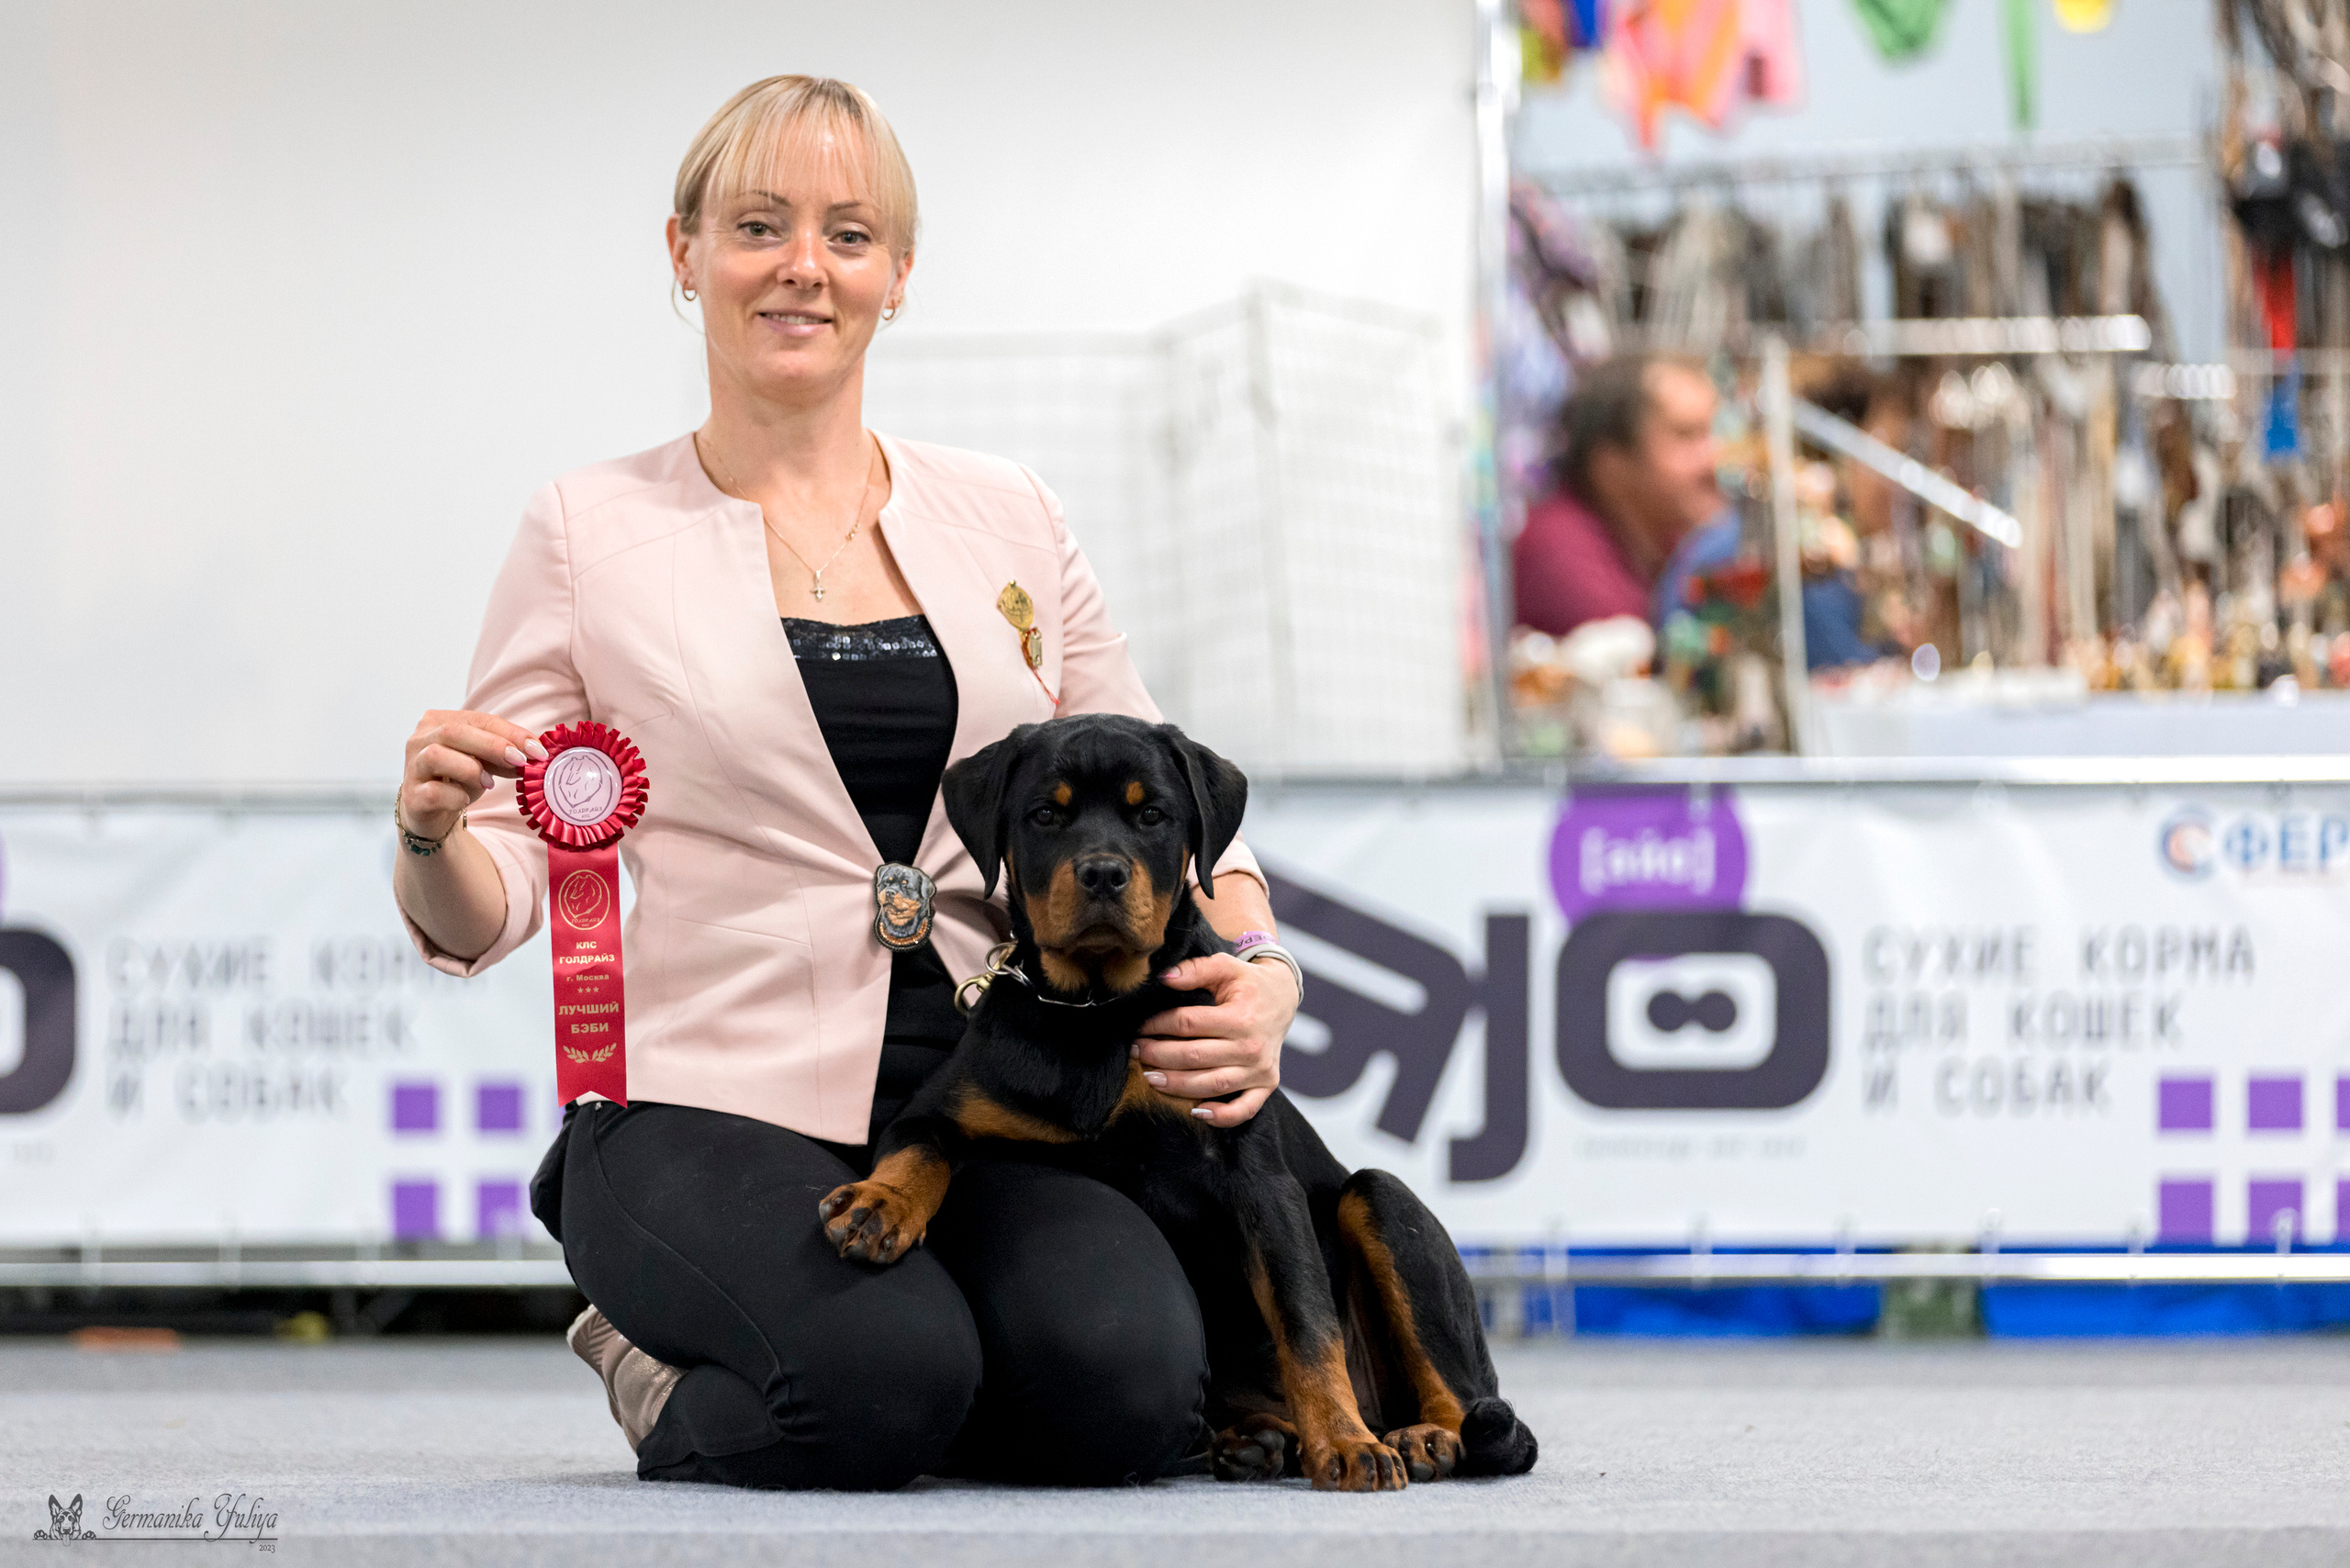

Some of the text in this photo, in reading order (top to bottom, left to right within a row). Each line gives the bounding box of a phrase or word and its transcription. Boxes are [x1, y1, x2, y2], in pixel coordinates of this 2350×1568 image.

[576, 941, 597, 950] КЛС
[559, 953, 615, 965] ГОЛДРАЙЗ
[1862, 924, 2255, 984] СУХИЕ КОРМА
[558, 1001, 620, 1015] ЛУЧШИЙ
[570, 1022, 610, 1034] БЭБИ
[1861, 990, 2183, 1053] ДЛЯ КОШЕК
[1863, 1056, 2109, 1118] И СОБАК
